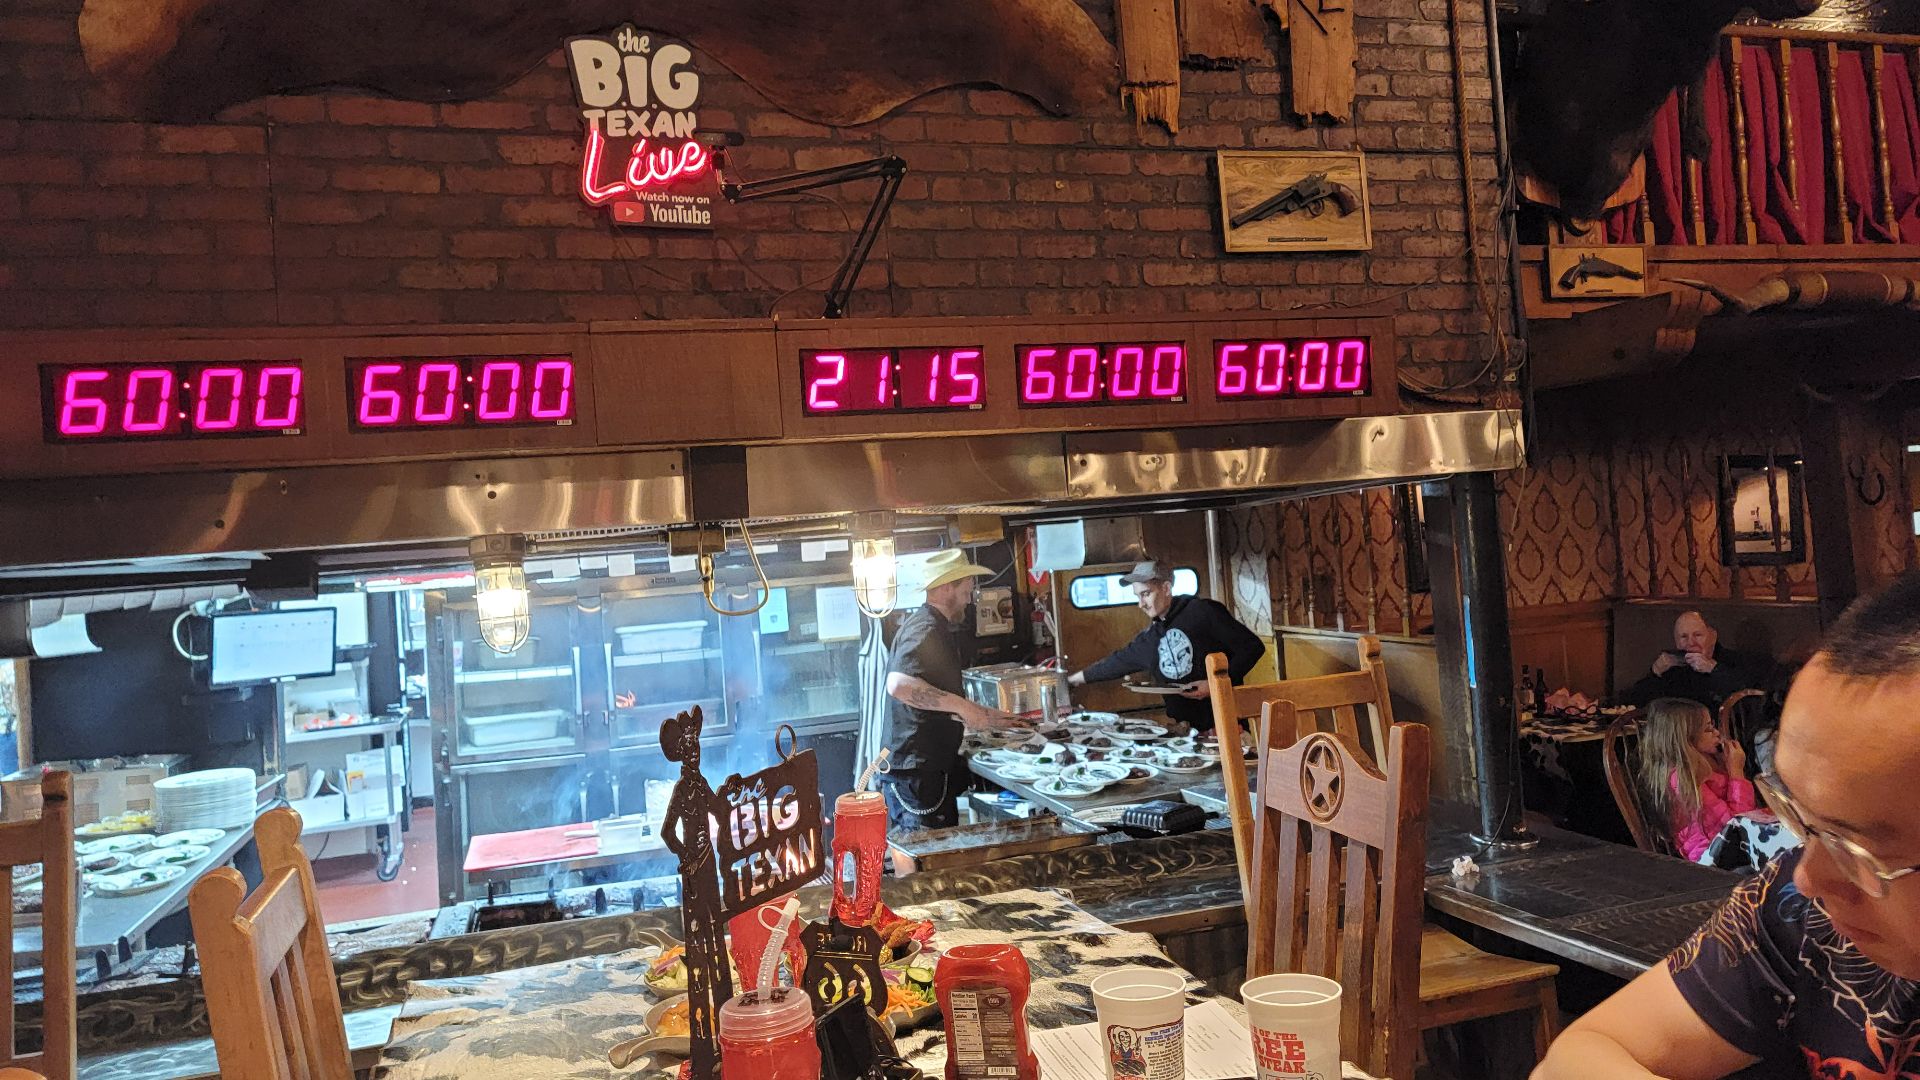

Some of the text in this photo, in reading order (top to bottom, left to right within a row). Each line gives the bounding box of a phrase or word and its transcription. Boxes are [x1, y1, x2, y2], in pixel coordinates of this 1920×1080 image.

[618, 28, 650, 53] the
[582, 109, 697, 138] TEXAN
[583, 130, 708, 203] Live
[636, 191, 710, 204] Watch now on
[650, 203, 711, 224] YouTube
[359, 361, 572, 424] 60:00
[809, 351, 980, 409] 21:15
[1025, 346, 1182, 400] 60:00
[1218, 341, 1364, 393] 60:00
[58, 366, 302, 434] 60:00
[730, 785, 799, 850] BIG
[730, 828, 816, 902] TEXAN
[1251, 1033, 1306, 1061] REE
[1259, 1028, 1271, 1038] OF
[1273, 1031, 1298, 1041] THE
[1258, 1055, 1306, 1074] STEAK
